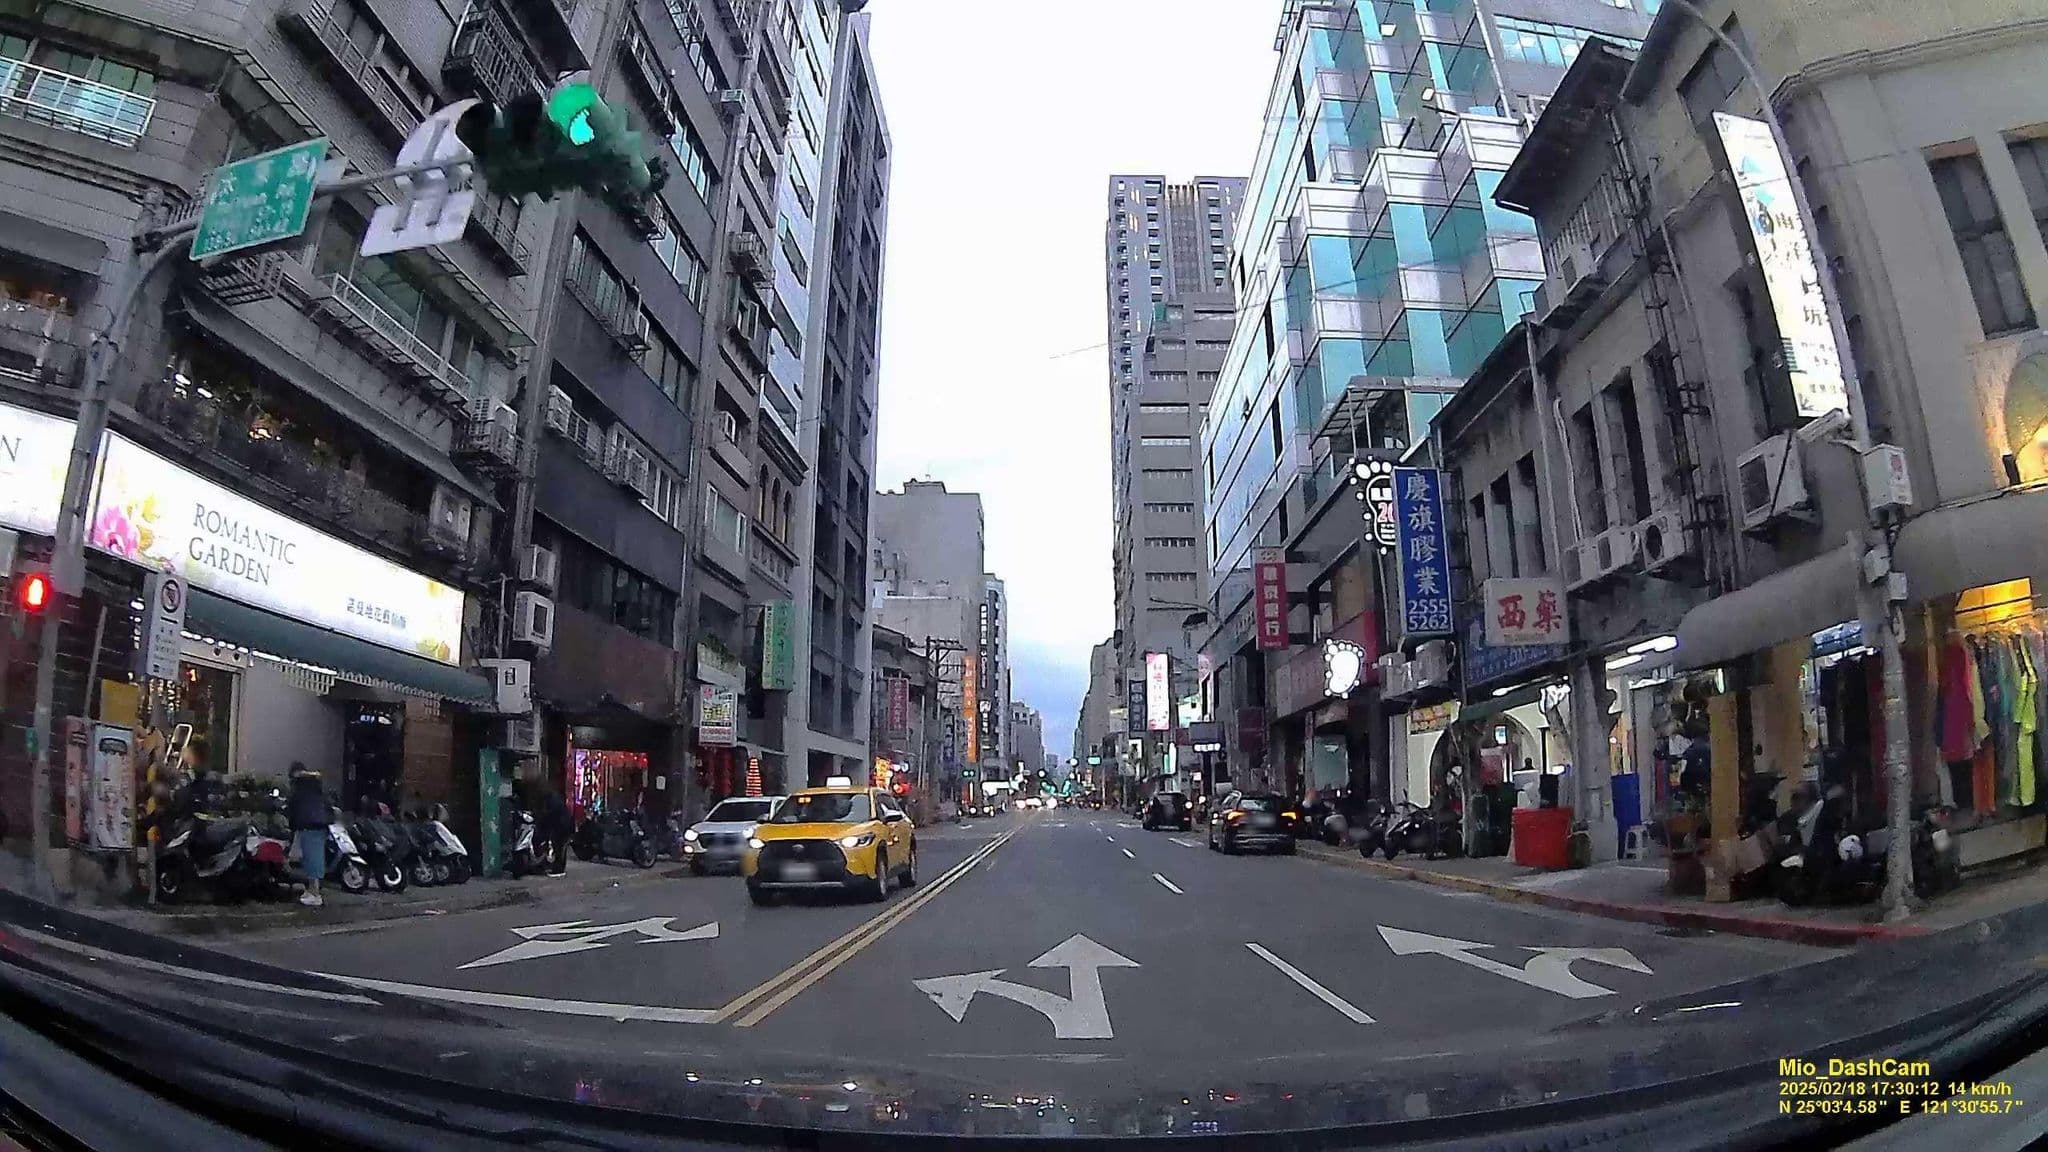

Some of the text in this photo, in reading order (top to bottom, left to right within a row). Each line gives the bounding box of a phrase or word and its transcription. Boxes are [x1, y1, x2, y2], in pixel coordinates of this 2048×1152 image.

[193, 502, 296, 564] ROMANTIC
[1404, 472, 1440, 595] 慶旗膠業
[189, 537, 270, 585] GARDEN
[1408, 599, 1449, 615] 2555
[1408, 615, 1450, 631] 5262
[1496, 589, 1562, 634] 西藥
